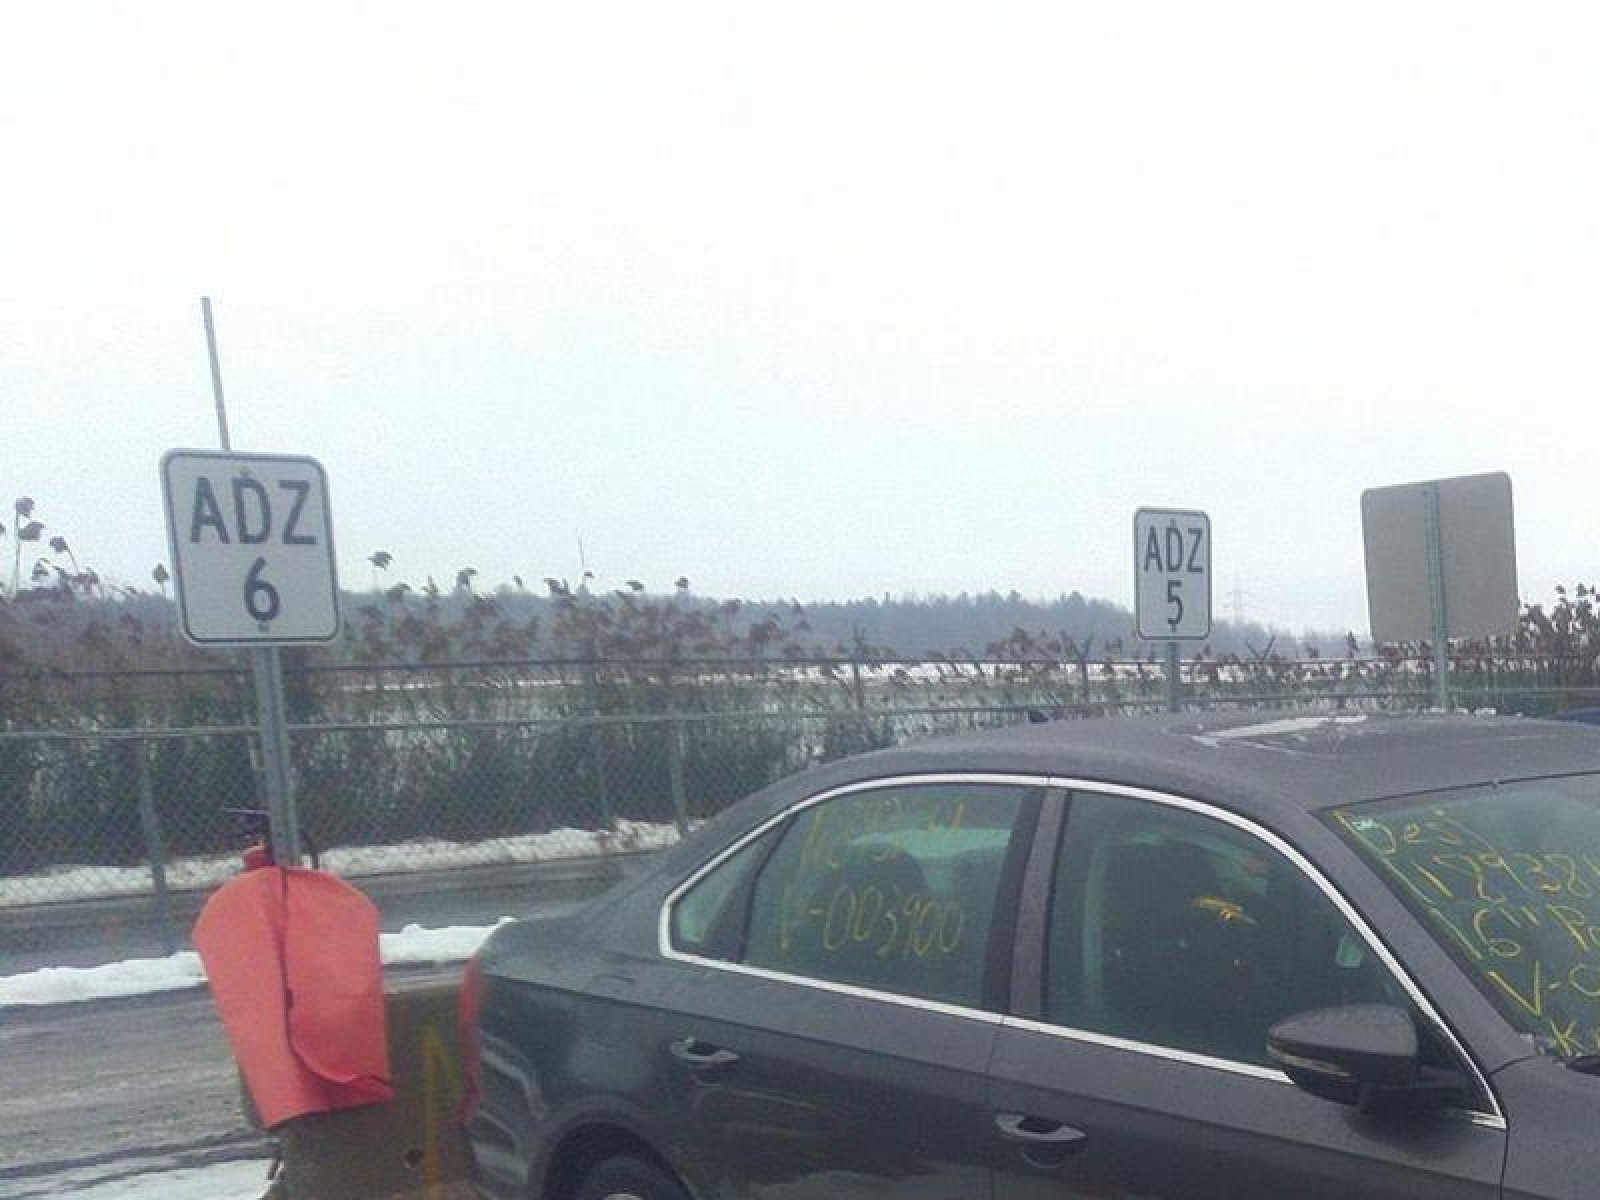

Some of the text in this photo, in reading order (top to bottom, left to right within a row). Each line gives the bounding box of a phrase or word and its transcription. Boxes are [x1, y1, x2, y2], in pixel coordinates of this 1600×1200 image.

[189, 476, 318, 545] ADZ
[1143, 525, 1204, 573] ADZ
[243, 556, 281, 622] 6
[1167, 579, 1184, 625] 5
